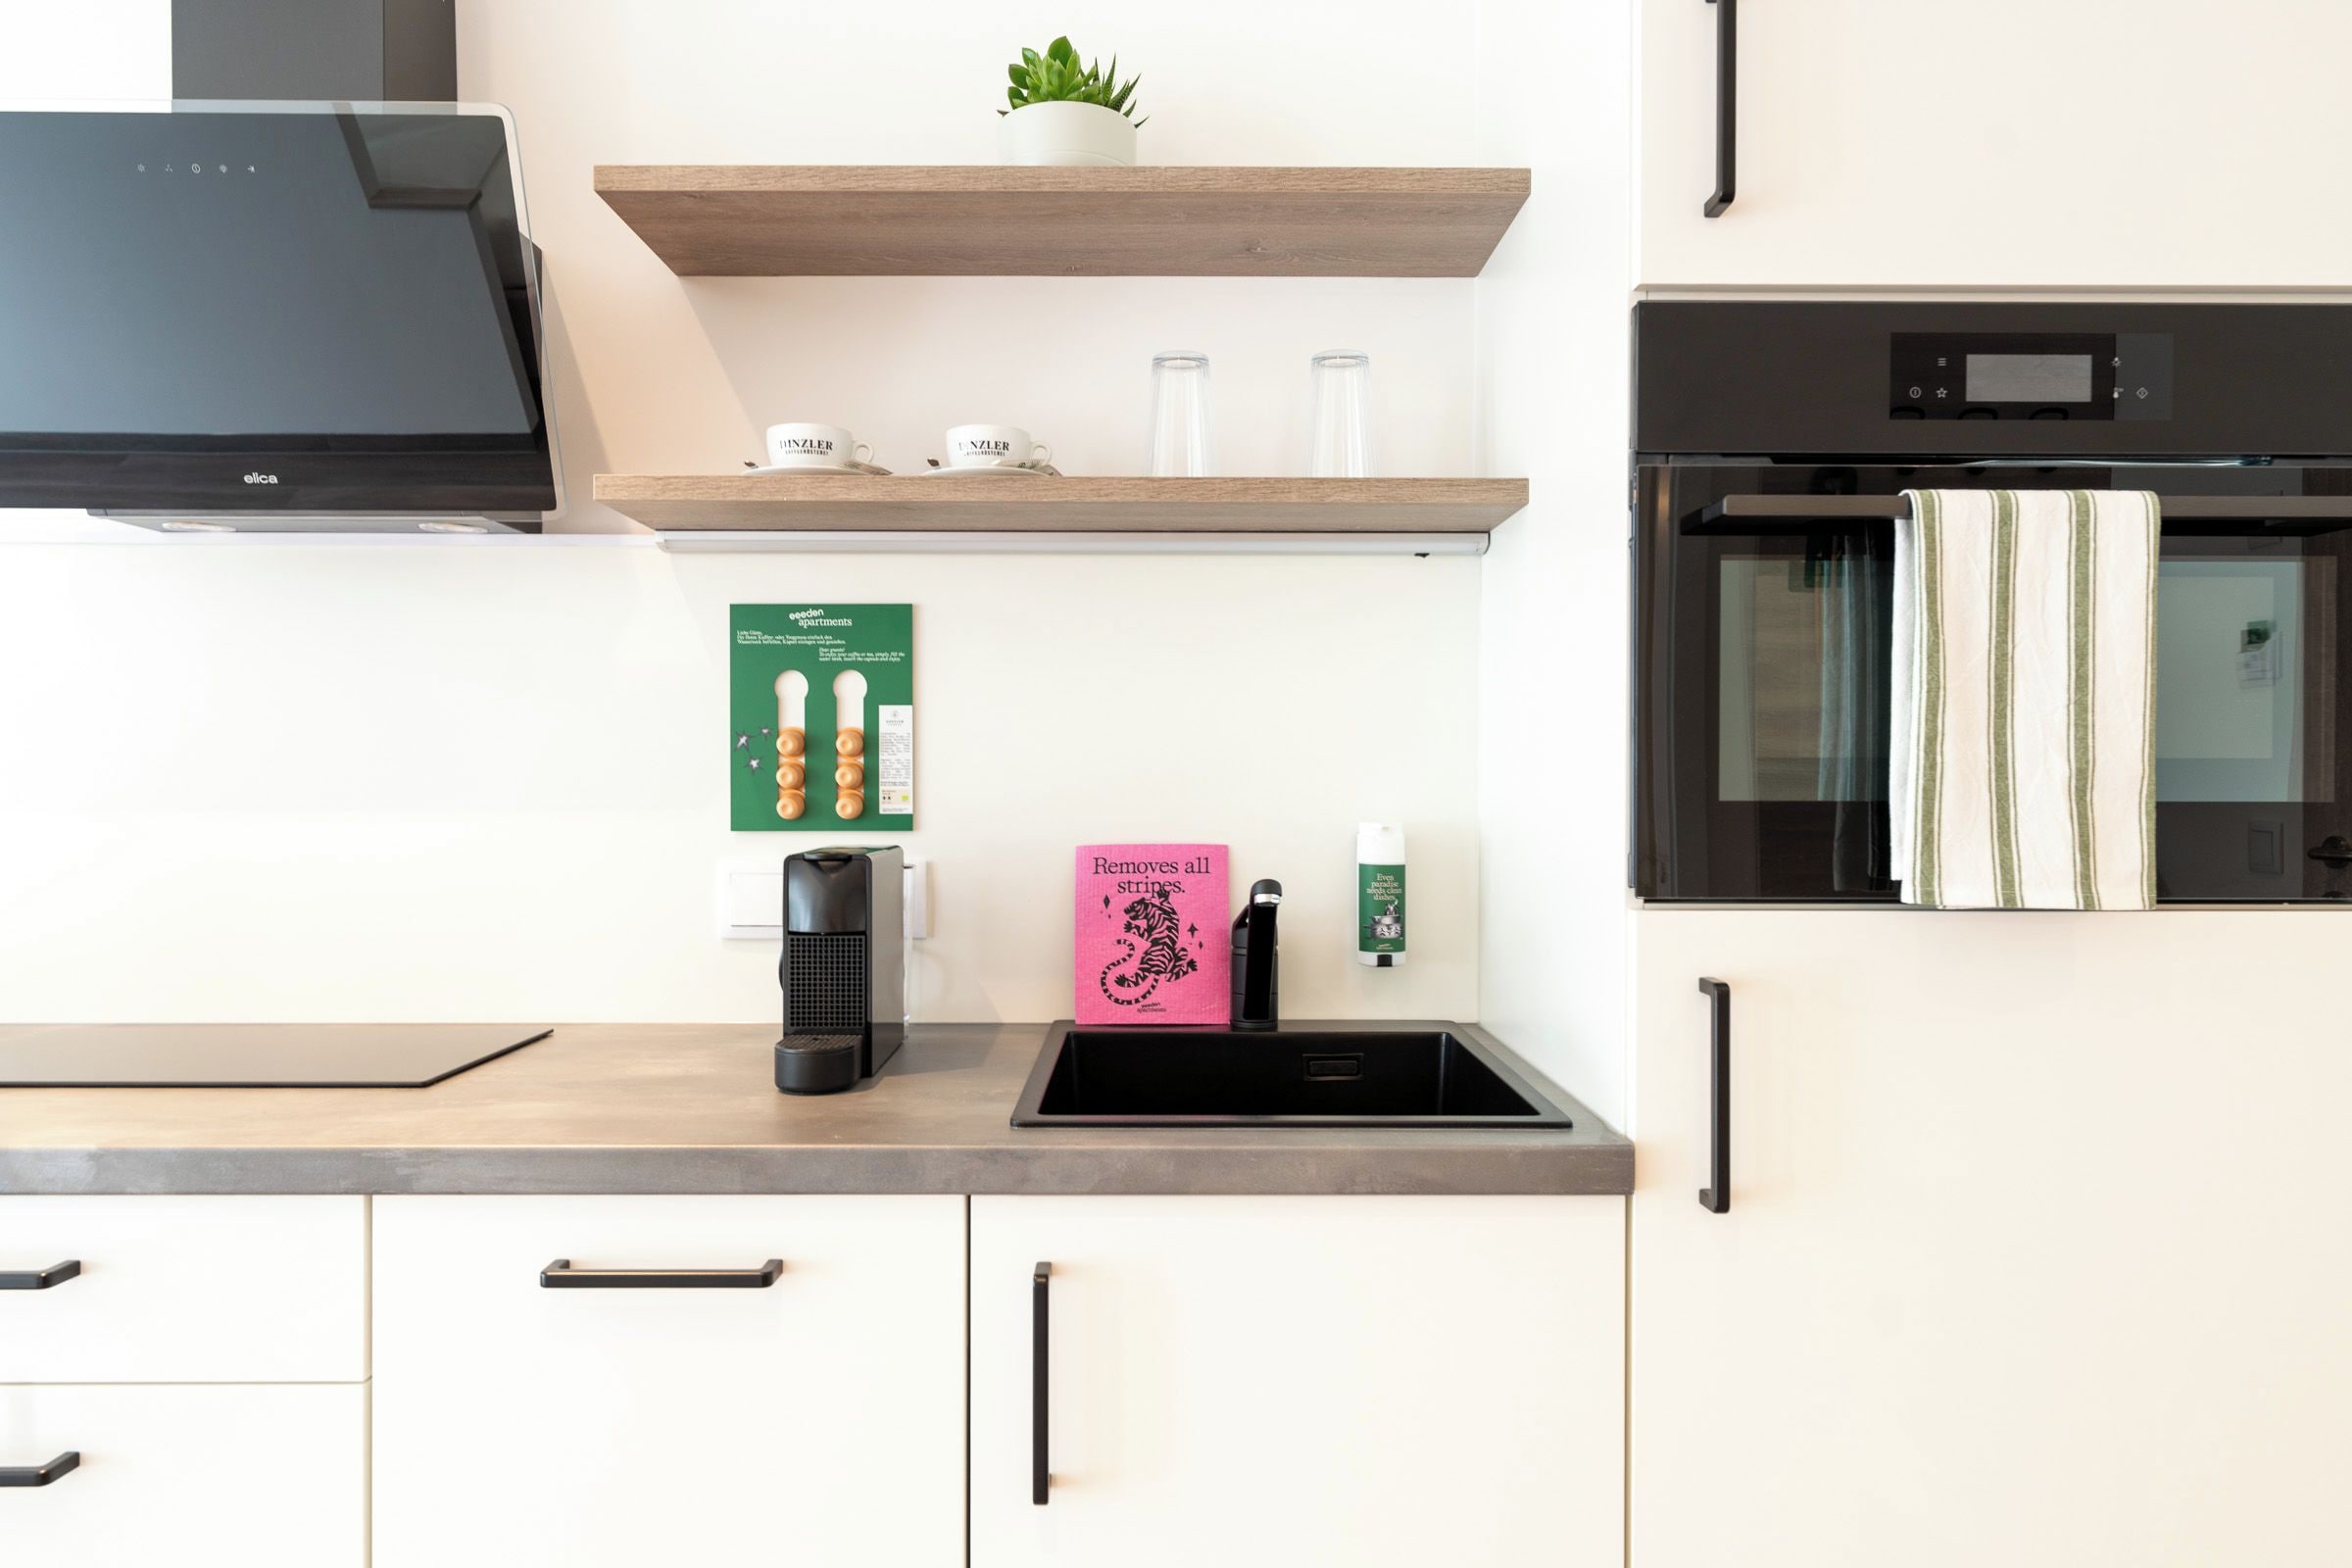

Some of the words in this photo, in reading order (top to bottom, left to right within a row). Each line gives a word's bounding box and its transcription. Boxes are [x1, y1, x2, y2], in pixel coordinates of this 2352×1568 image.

[958, 440, 1009, 452] NZLER
[243, 471, 278, 484] elica
[789, 608, 824, 620] eeeden
[798, 618, 853, 628] apartments
[1093, 857, 1179, 874] Removes
[1184, 857, 1210, 874] all
[1117, 875, 1186, 898] stripes.
[1371, 880, 1399, 889] paradise
